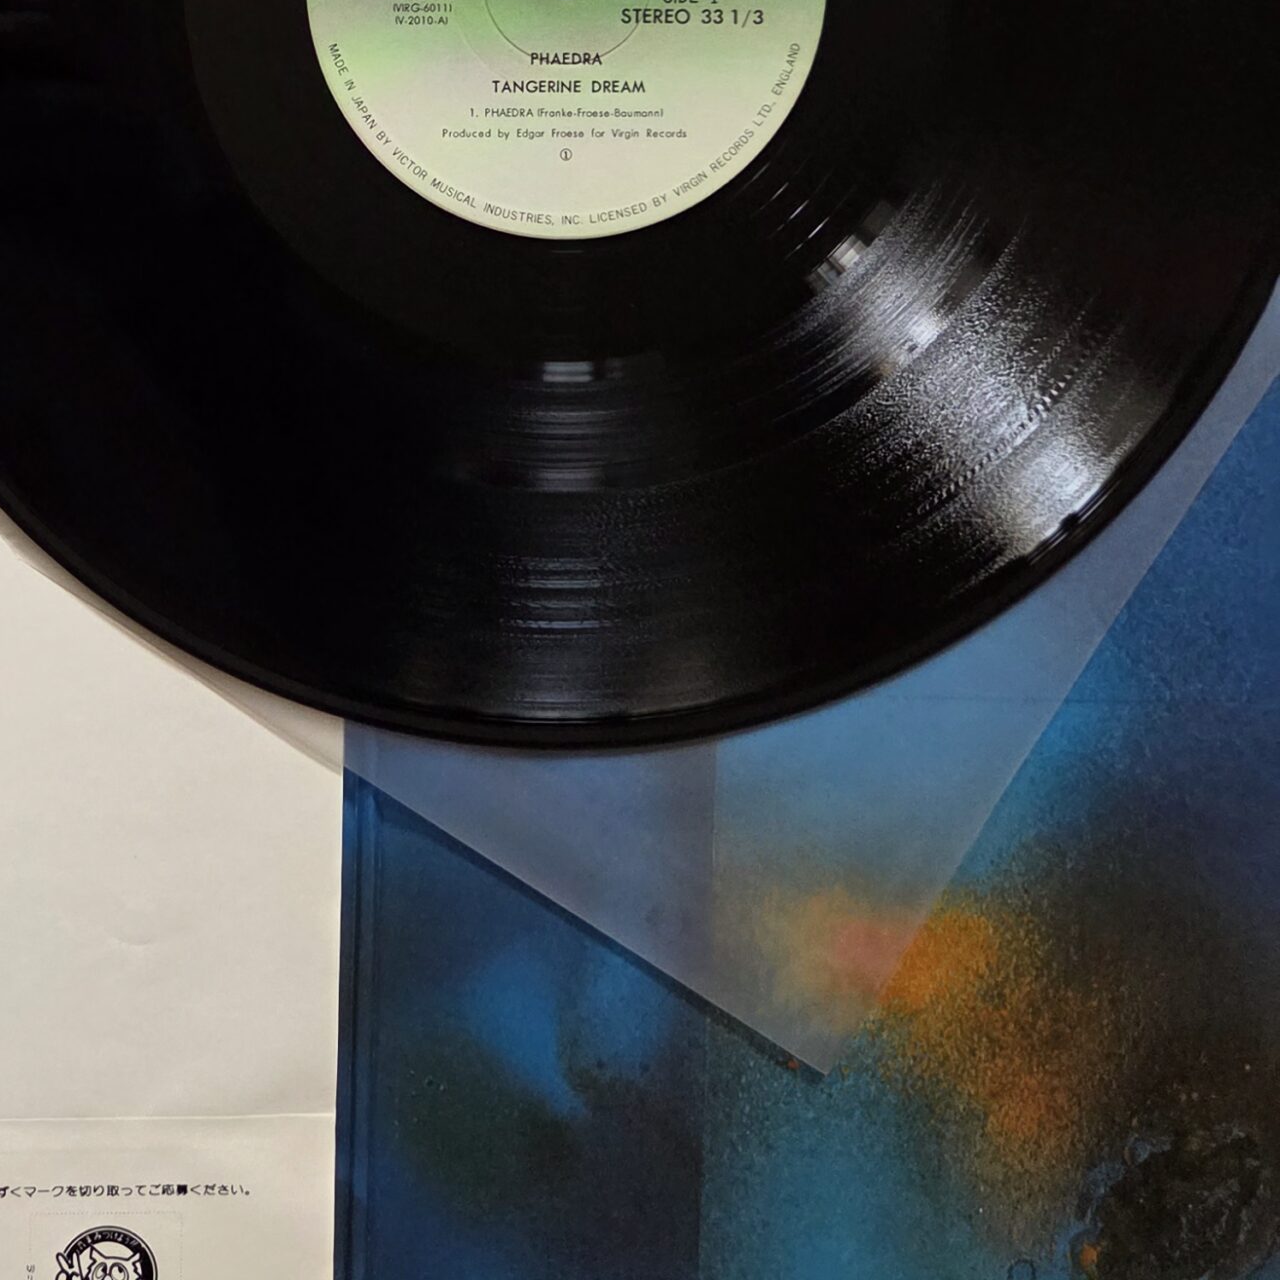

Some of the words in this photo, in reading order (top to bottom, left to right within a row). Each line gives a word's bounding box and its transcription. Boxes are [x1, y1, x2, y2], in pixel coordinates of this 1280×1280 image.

[395, 15, 448, 25] (V-2010-A)
[621, 8, 691, 25] STEREO
[701, 8, 724, 25] 33
[732, 8, 764, 28] 1/3
[530, 52, 603, 66] PHAEDRA
[492, 80, 582, 94] TANGERINE
[591, 80, 647, 94] DREAM
[469, 107, 479, 119] 1.
[484, 107, 534, 119] PHAEDRA
[328, 43, 349, 76] MADE
[344, 79, 357, 92] IN
[351, 96, 378, 130] JAPAN
[376, 128, 392, 146] BY
[392, 146, 428, 181] VICTOR
[430, 177, 477, 208] MUSICAL
[483, 201, 555, 226] INDUSTRIES,
[561, 215, 583, 225] INC.
[589, 201, 648, 224] LICENSED
[652, 193, 668, 208] BY
[672, 170, 708, 197] VIRGIN
[709, 128, 756, 173] RECORDS
[771, 42, 801, 96] ENGLAND
[441, 128, 492, 139] Produced
[498, 128, 511, 141] by
[516, 128, 545, 141] Edgar
[550, 128, 585, 139] Froese
[591, 128, 606, 139] for
[611, 128, 640, 141] Virgin
[646, 128, 687, 139] Records
